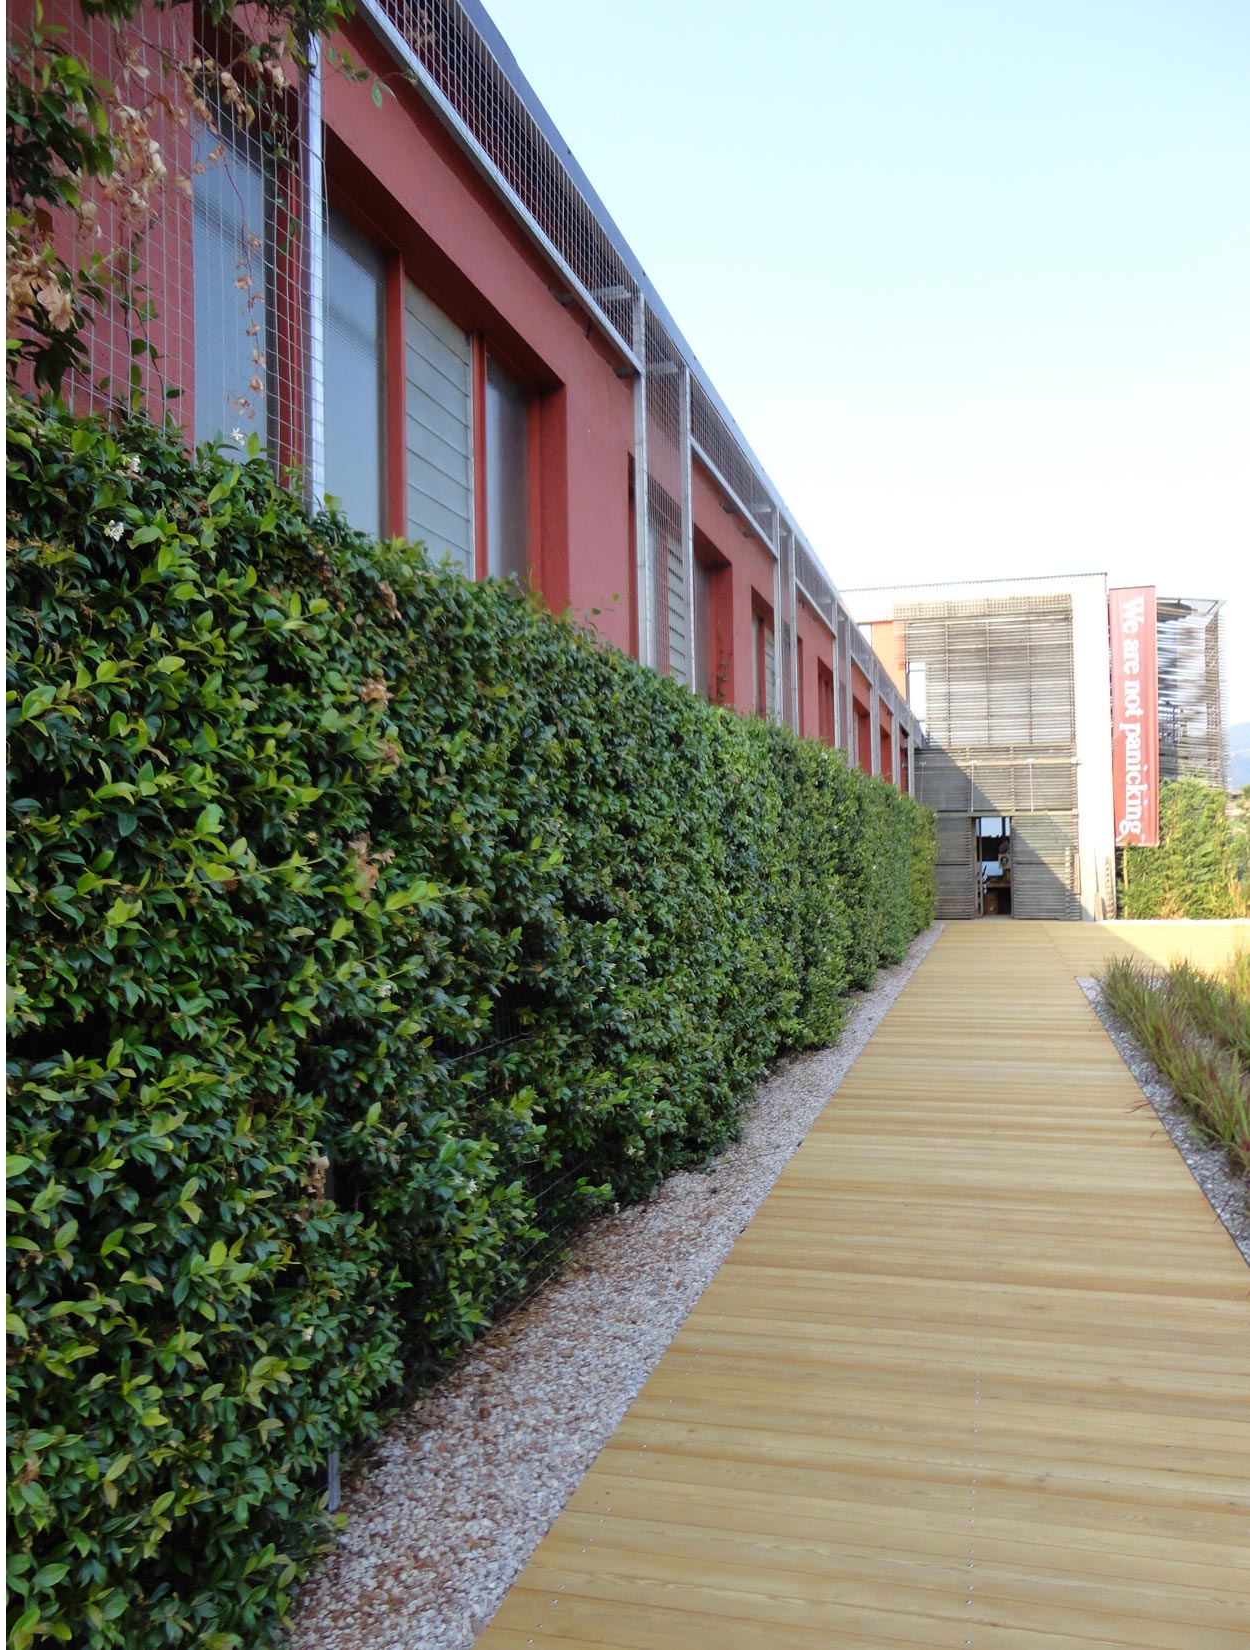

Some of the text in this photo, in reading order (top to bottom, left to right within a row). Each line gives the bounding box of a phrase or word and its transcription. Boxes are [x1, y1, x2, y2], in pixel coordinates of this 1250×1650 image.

[1122, 595, 1145, 634] We
[1123, 639, 1140, 675] are
[1124, 679, 1144, 718] not
